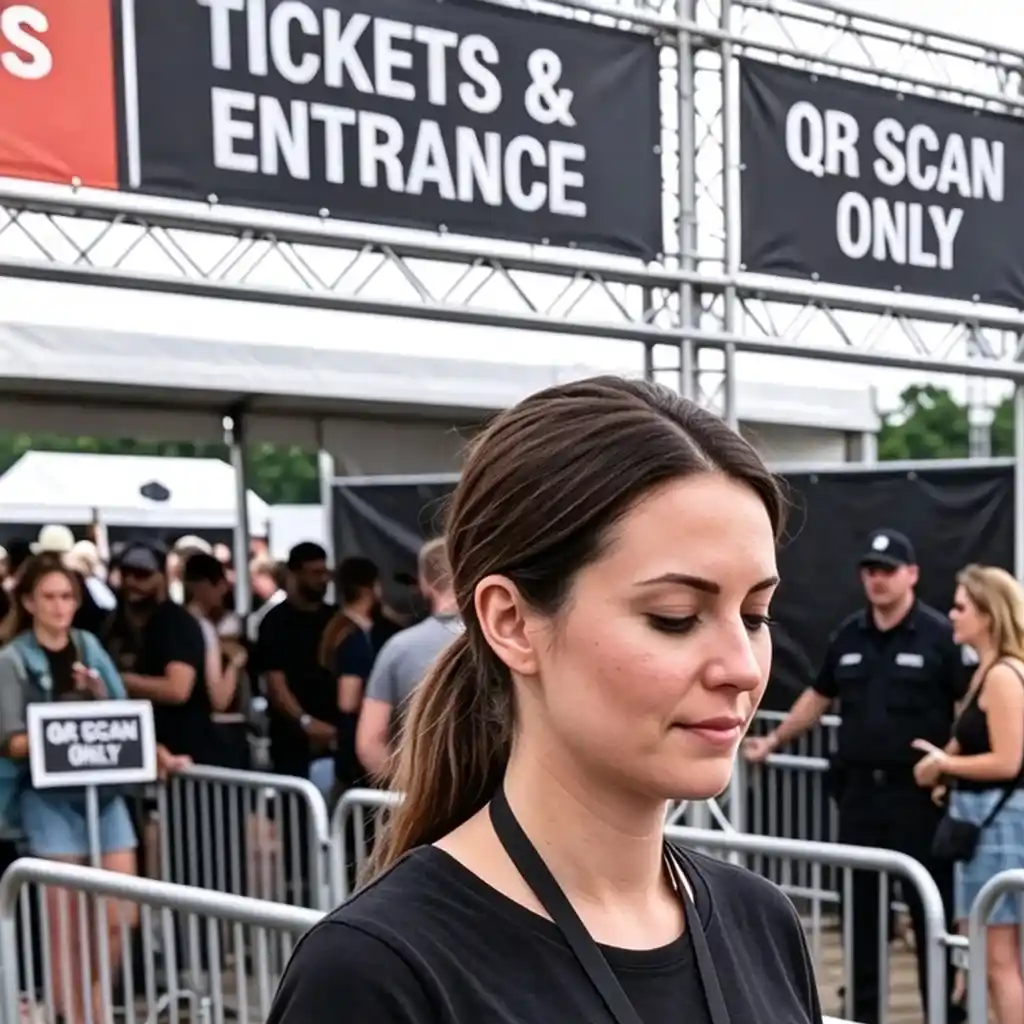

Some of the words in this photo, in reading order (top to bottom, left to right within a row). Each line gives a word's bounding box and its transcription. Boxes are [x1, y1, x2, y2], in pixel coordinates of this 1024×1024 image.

[0, 4, 53, 80] S
[196, 0, 502, 114] TICKETS
[524, 48, 576, 126] &
[210, 86, 587, 218] ENTRANCE
[786, 101, 860, 178] QR
[873, 117, 1005, 202] SCAN
[836, 191, 974, 270] ONLY
[67, 742, 122, 767] ONLY
